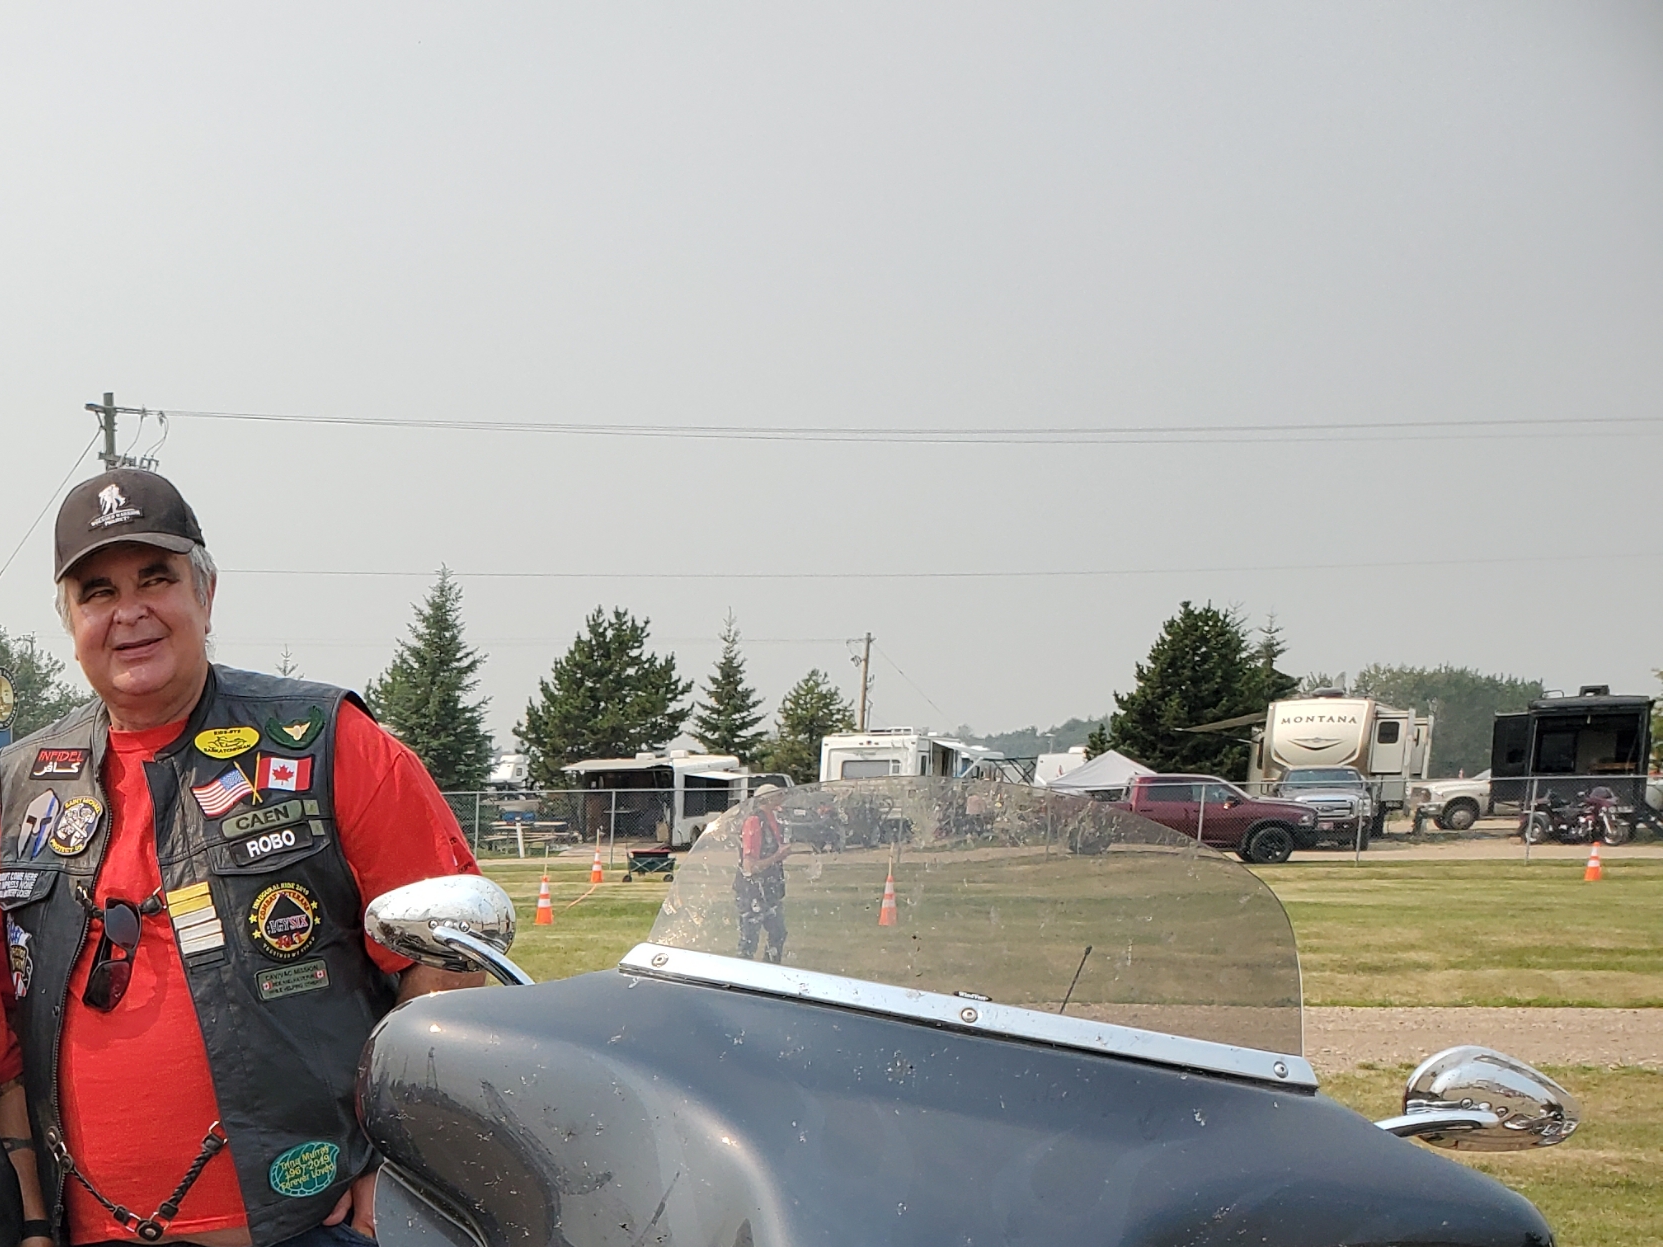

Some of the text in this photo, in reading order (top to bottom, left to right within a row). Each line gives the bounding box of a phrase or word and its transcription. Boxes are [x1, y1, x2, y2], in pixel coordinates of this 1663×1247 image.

[1280, 715, 1358, 725] MONTANA
[38, 750, 85, 762] INFIDEL
[33, 761, 81, 776] كافر
[235, 805, 290, 830] CAEN
[246, 829, 296, 858] ROBO
